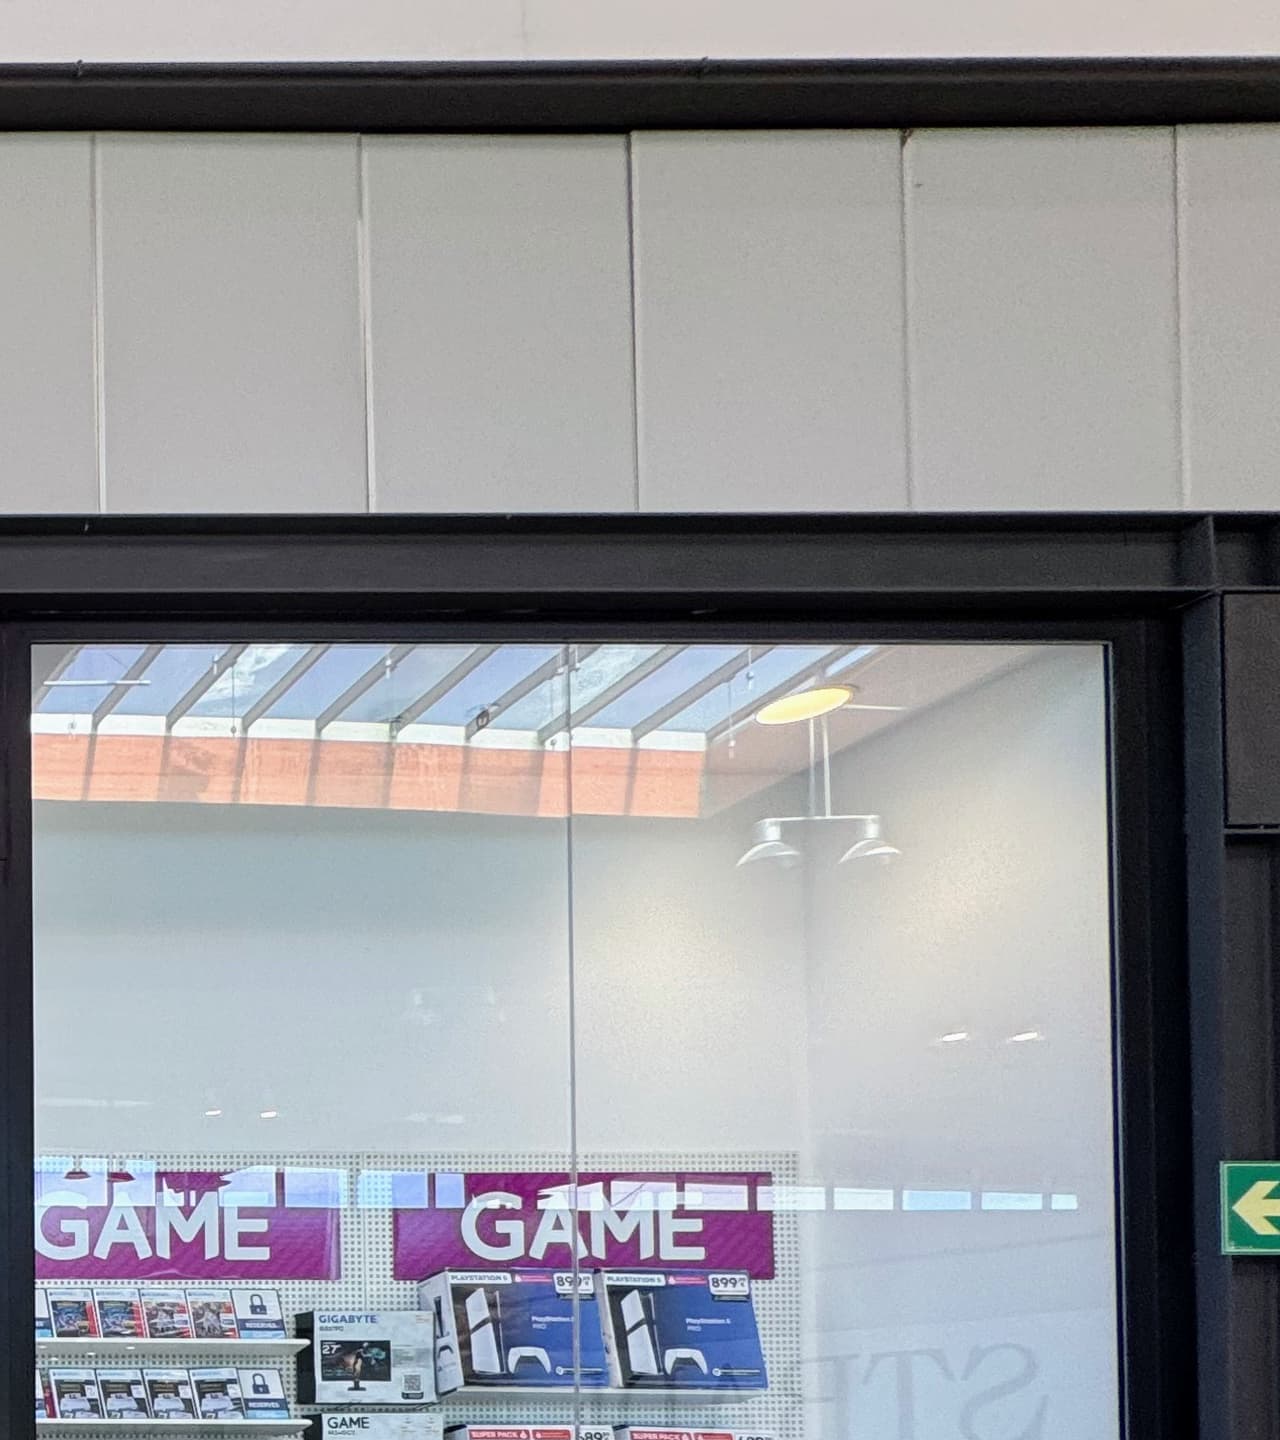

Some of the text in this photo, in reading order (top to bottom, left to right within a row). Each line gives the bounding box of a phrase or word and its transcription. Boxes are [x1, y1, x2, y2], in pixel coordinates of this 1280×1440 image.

[35, 1190, 271, 1262] GAME
[461, 1191, 706, 1261] GAME
[711, 1276, 738, 1288] 899
[318, 1314, 378, 1324] GIGABYTE
[326, 1416, 370, 1429] GAME
